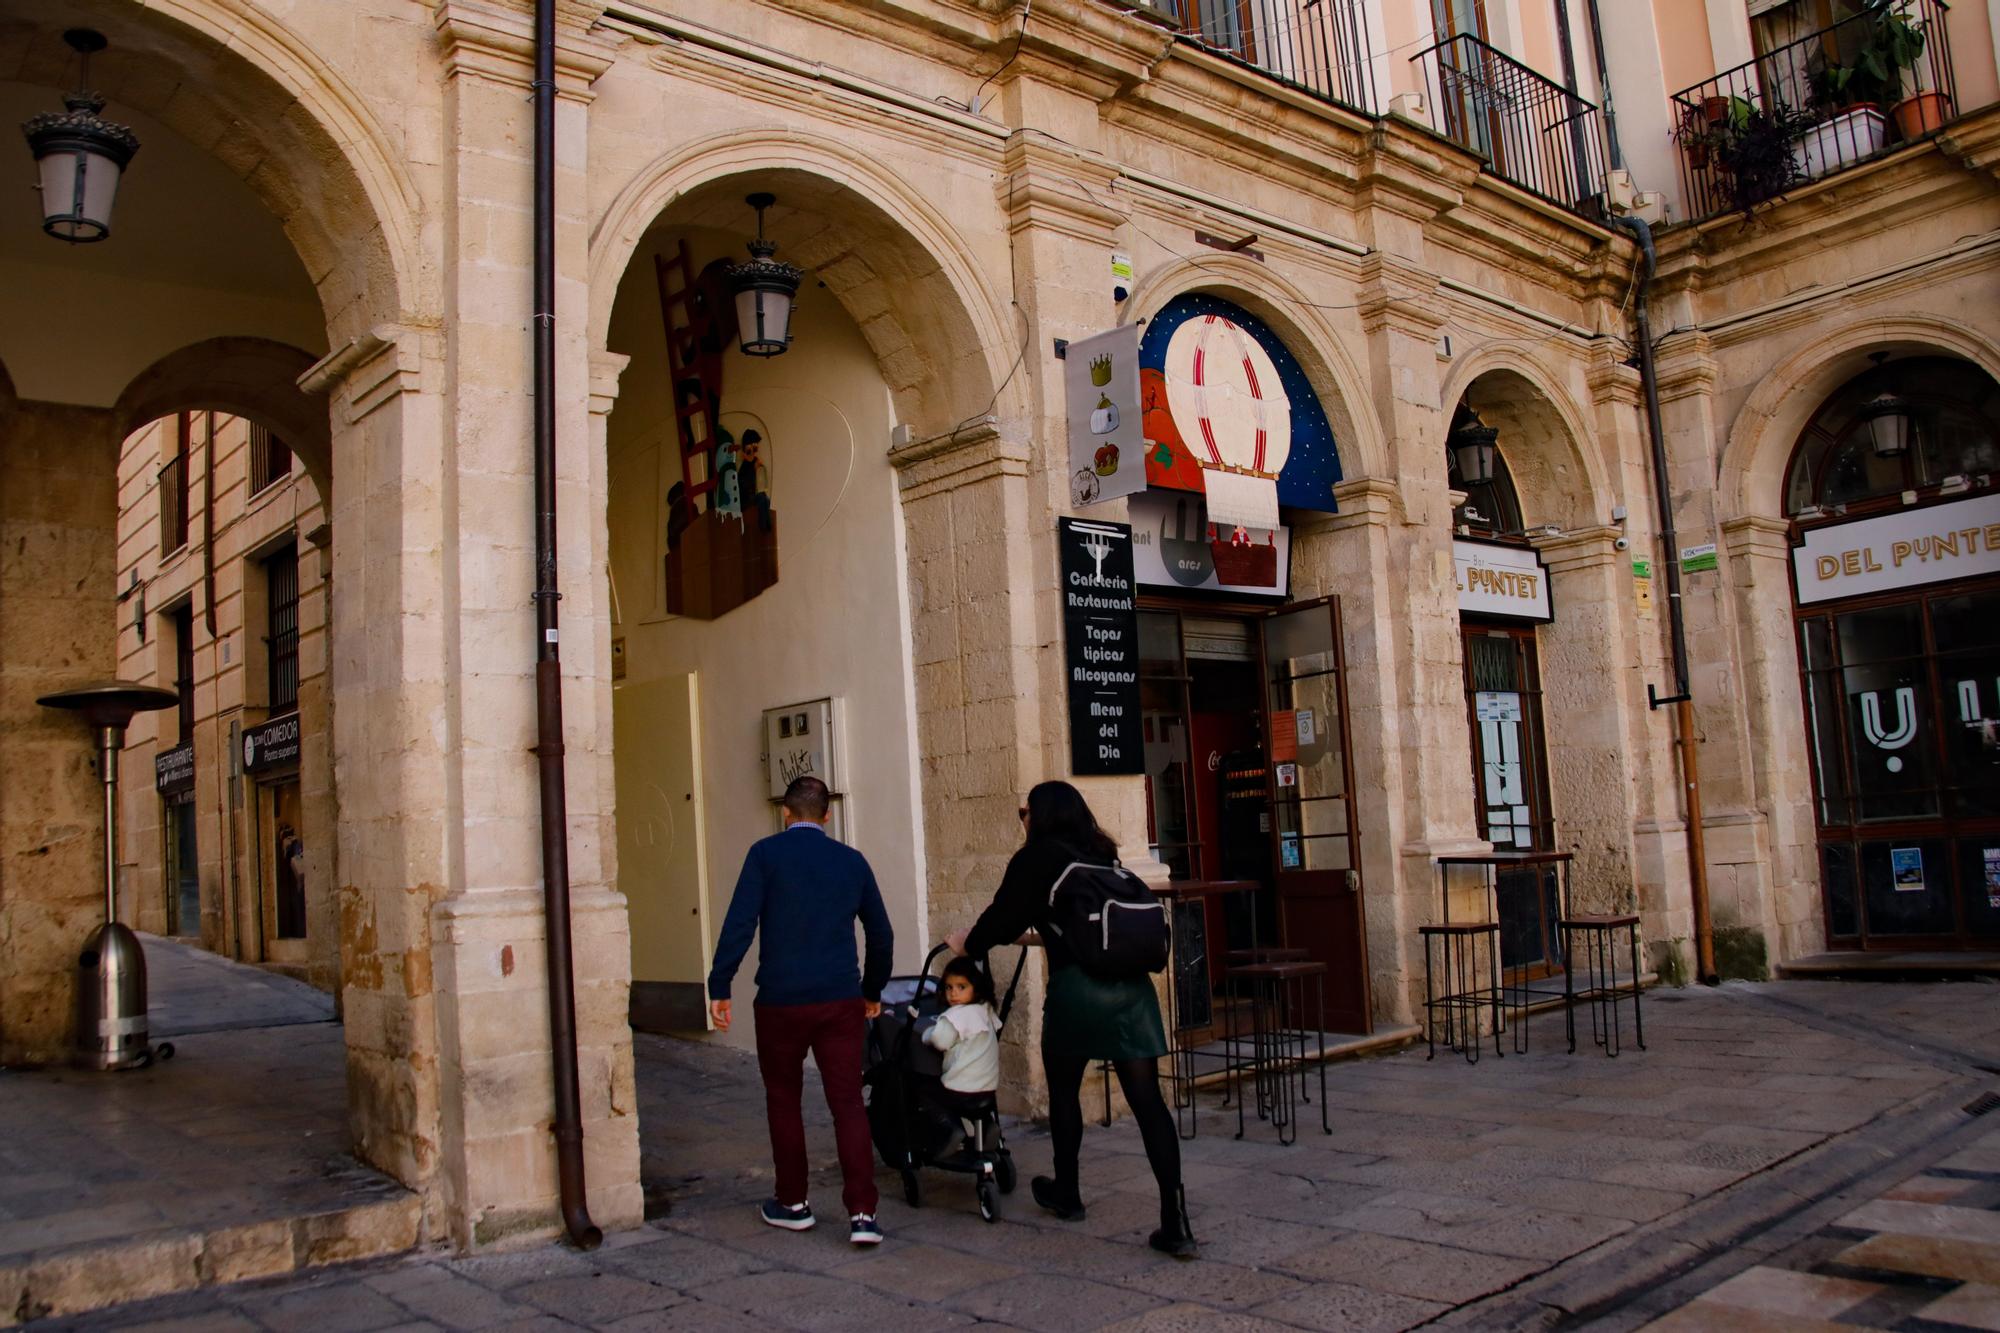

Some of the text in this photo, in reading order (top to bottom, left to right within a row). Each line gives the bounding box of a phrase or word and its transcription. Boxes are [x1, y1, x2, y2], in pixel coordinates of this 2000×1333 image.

[1178, 559, 1201, 571] arcs
[1473, 554, 1486, 568] Bar
[1816, 547, 1882, 581] DEL
[1069, 571, 1128, 590] Cafeteria
[1467, 567, 1538, 599] PUNTET
[1068, 592, 1132, 610] Restaurant
[1085, 625, 1122, 642] Tapas
[1073, 667, 1136, 686] Alcoyanas
[1090, 702, 1123, 717] Menu
[264, 720, 298, 746] COMEDOR
[1099, 722, 1119, 738] del
[1099, 744, 1120, 759] Dia
